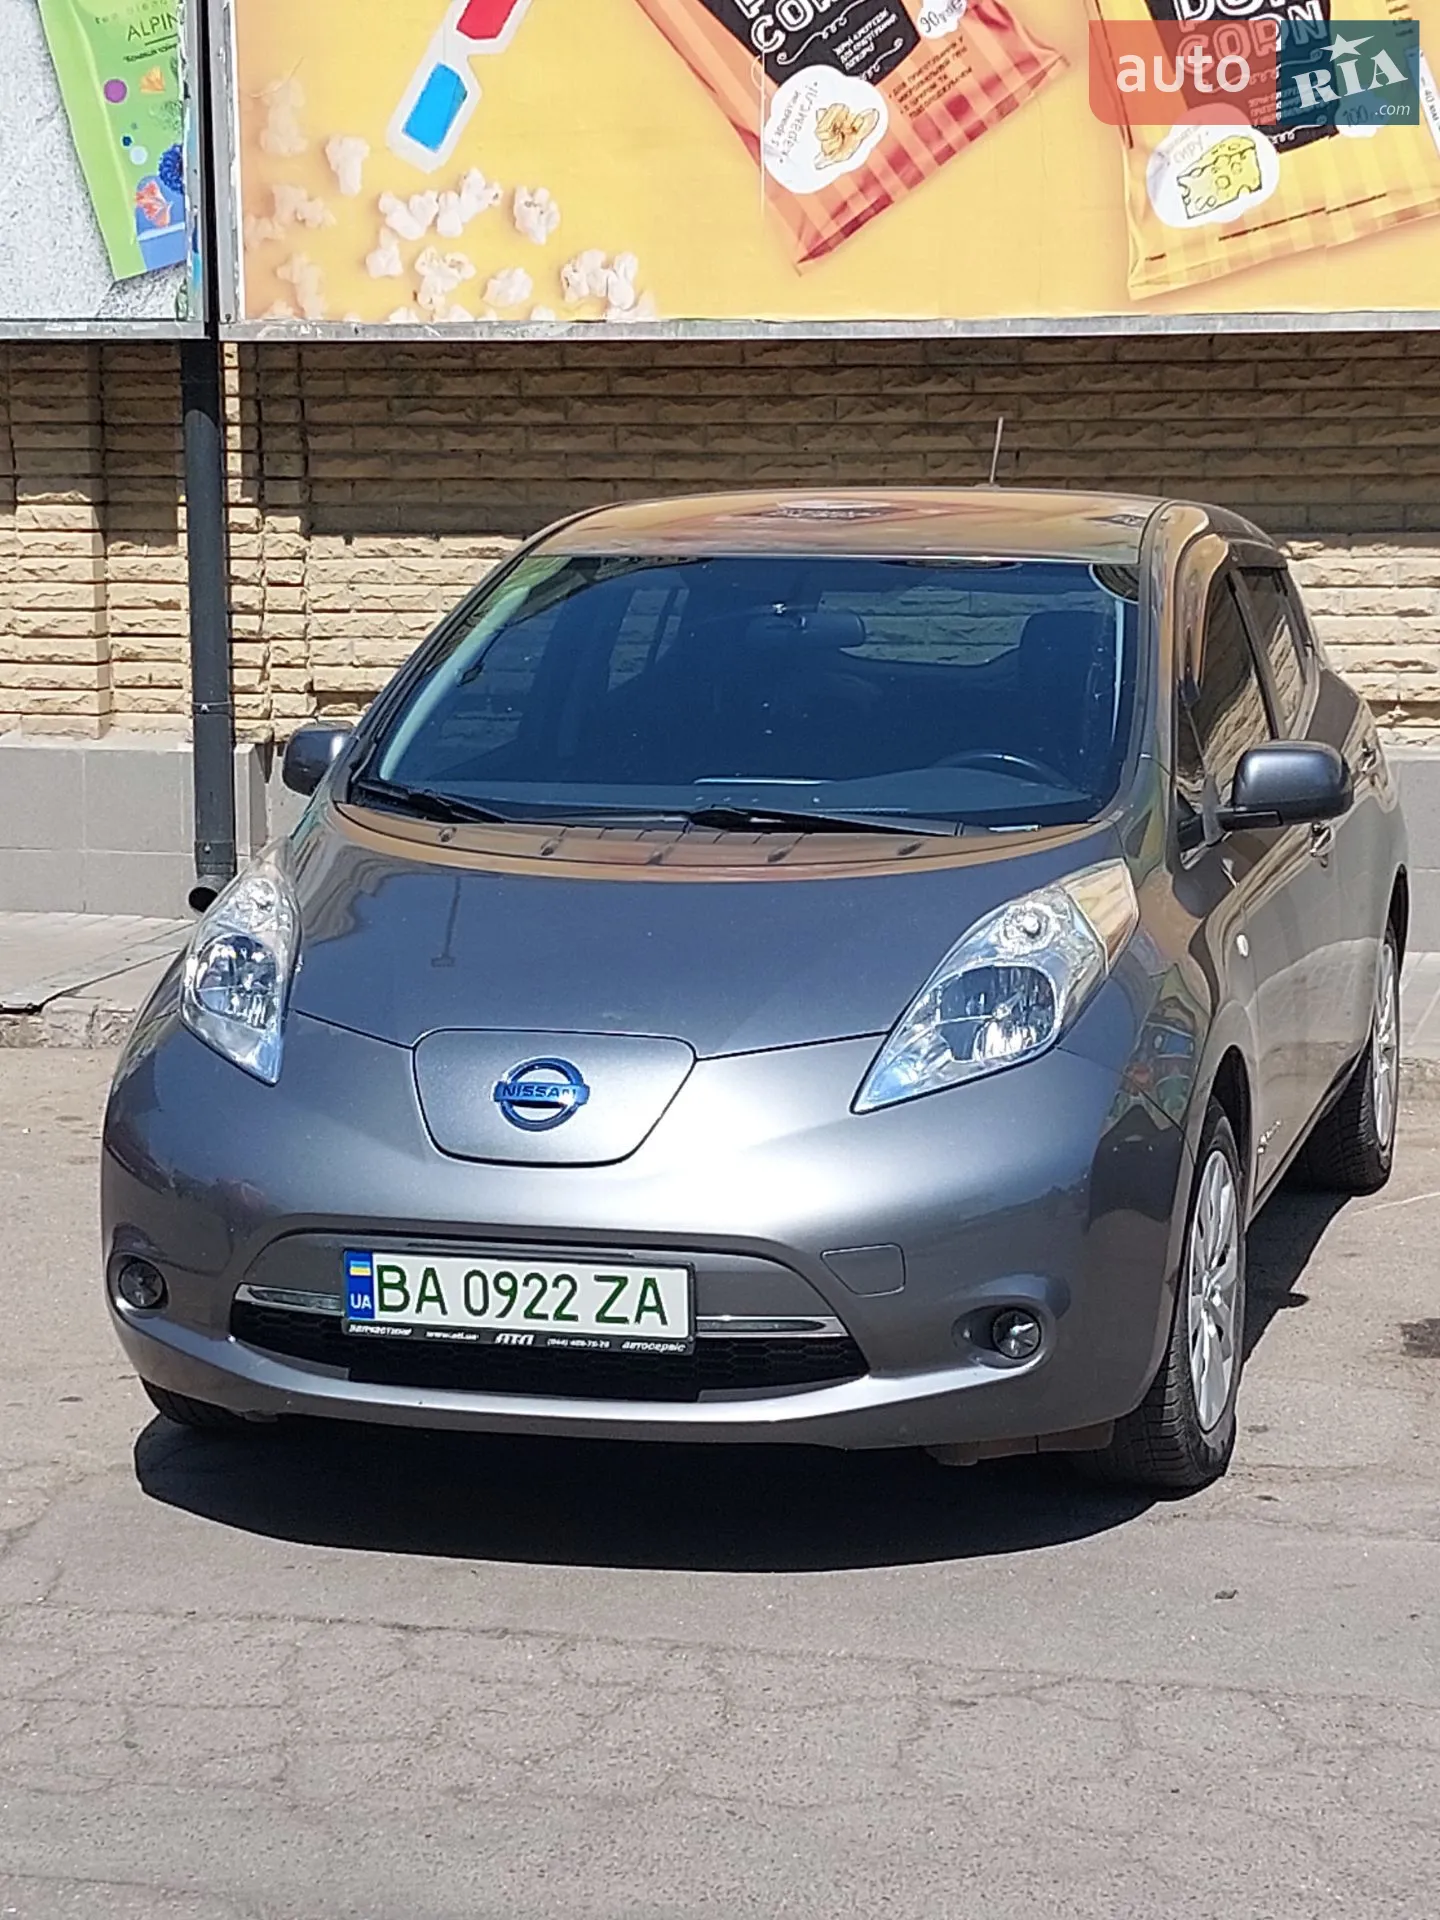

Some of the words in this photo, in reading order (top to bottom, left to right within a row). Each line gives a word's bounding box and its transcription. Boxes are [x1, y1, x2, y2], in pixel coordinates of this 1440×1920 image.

[350, 1293, 372, 1311] UA
[376, 1264, 448, 1316] BA
[464, 1269, 579, 1322] 0922
[594, 1274, 668, 1326] ZA
